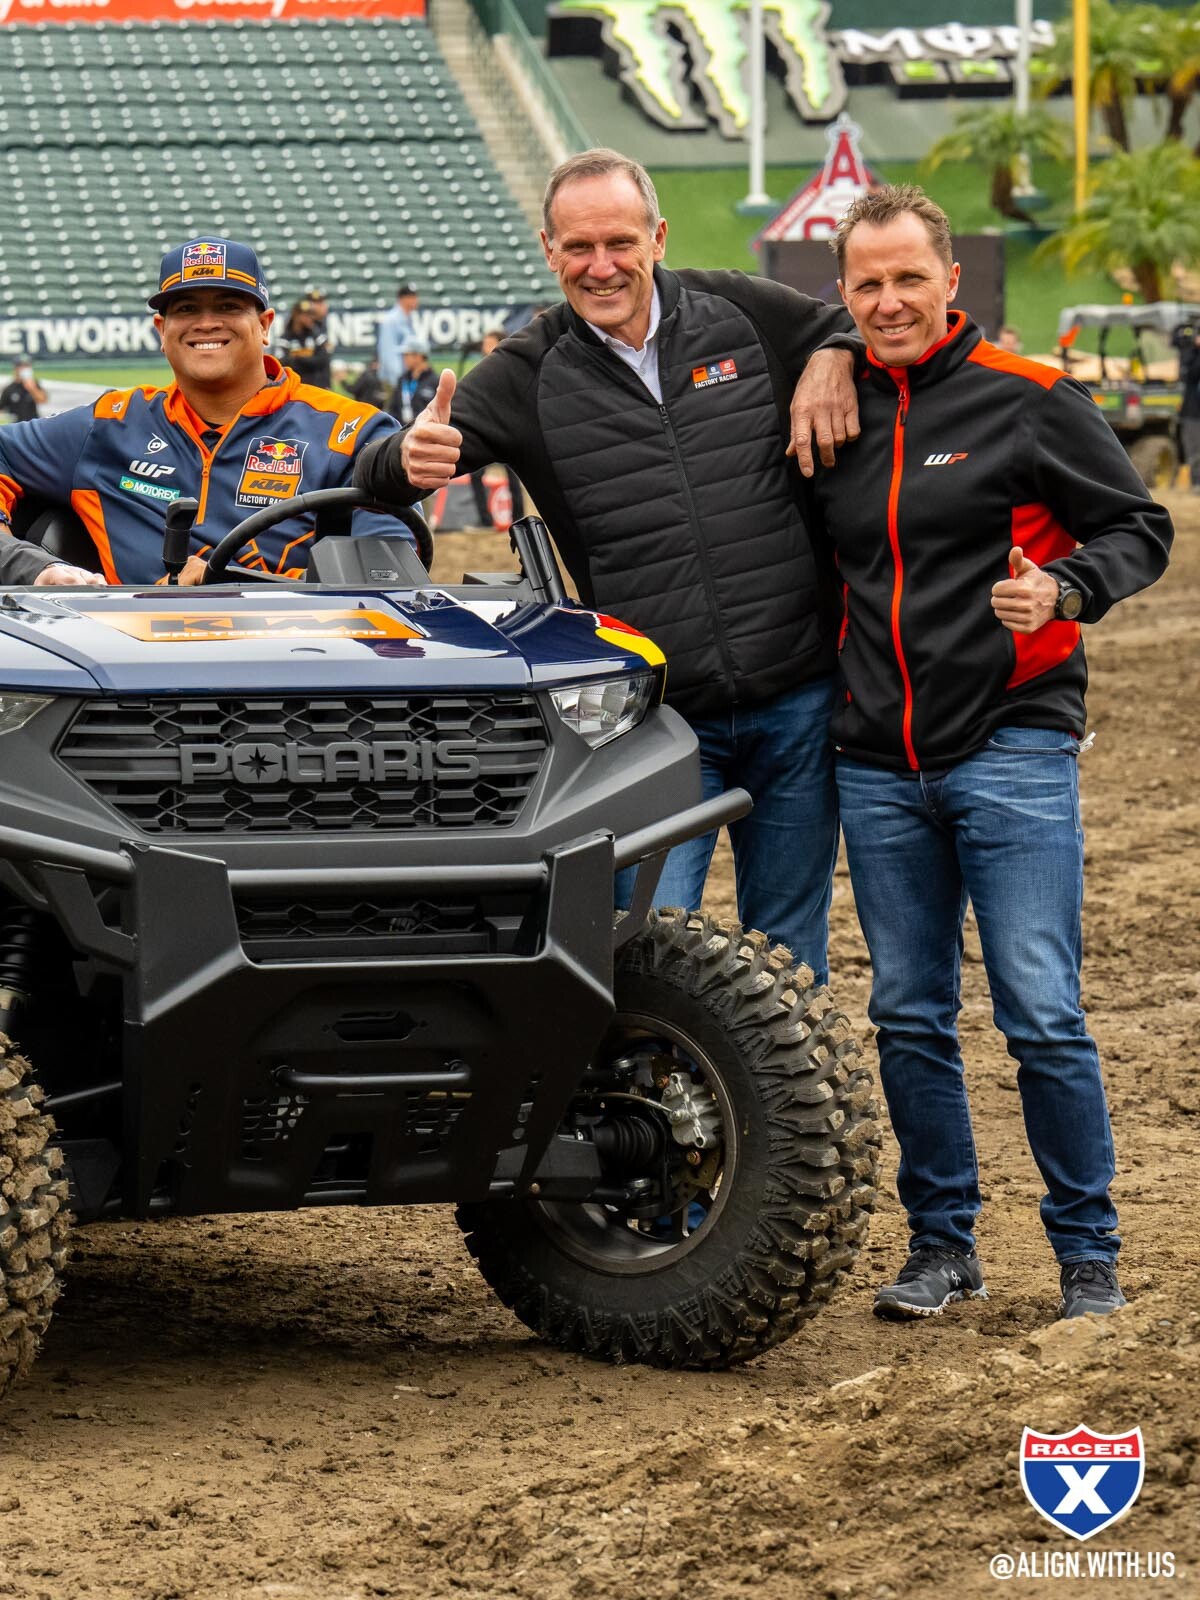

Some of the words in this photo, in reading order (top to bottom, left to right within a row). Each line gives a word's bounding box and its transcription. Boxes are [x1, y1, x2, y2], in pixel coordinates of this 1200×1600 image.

[184, 256, 203, 266] Red
[204, 254, 224, 264] Bull
[191, 267, 215, 276] KTM
[694, 377, 719, 389] FACTORY
[247, 455, 276, 473] Red
[275, 459, 300, 474] Bull
[923, 452, 969, 466] WP
[129, 460, 176, 478] WP
[133, 481, 177, 500] MOTOREX
[248, 478, 292, 493] KTM
[239, 494, 268, 505] FACTORY
[180, 739, 481, 785] POLARIS
